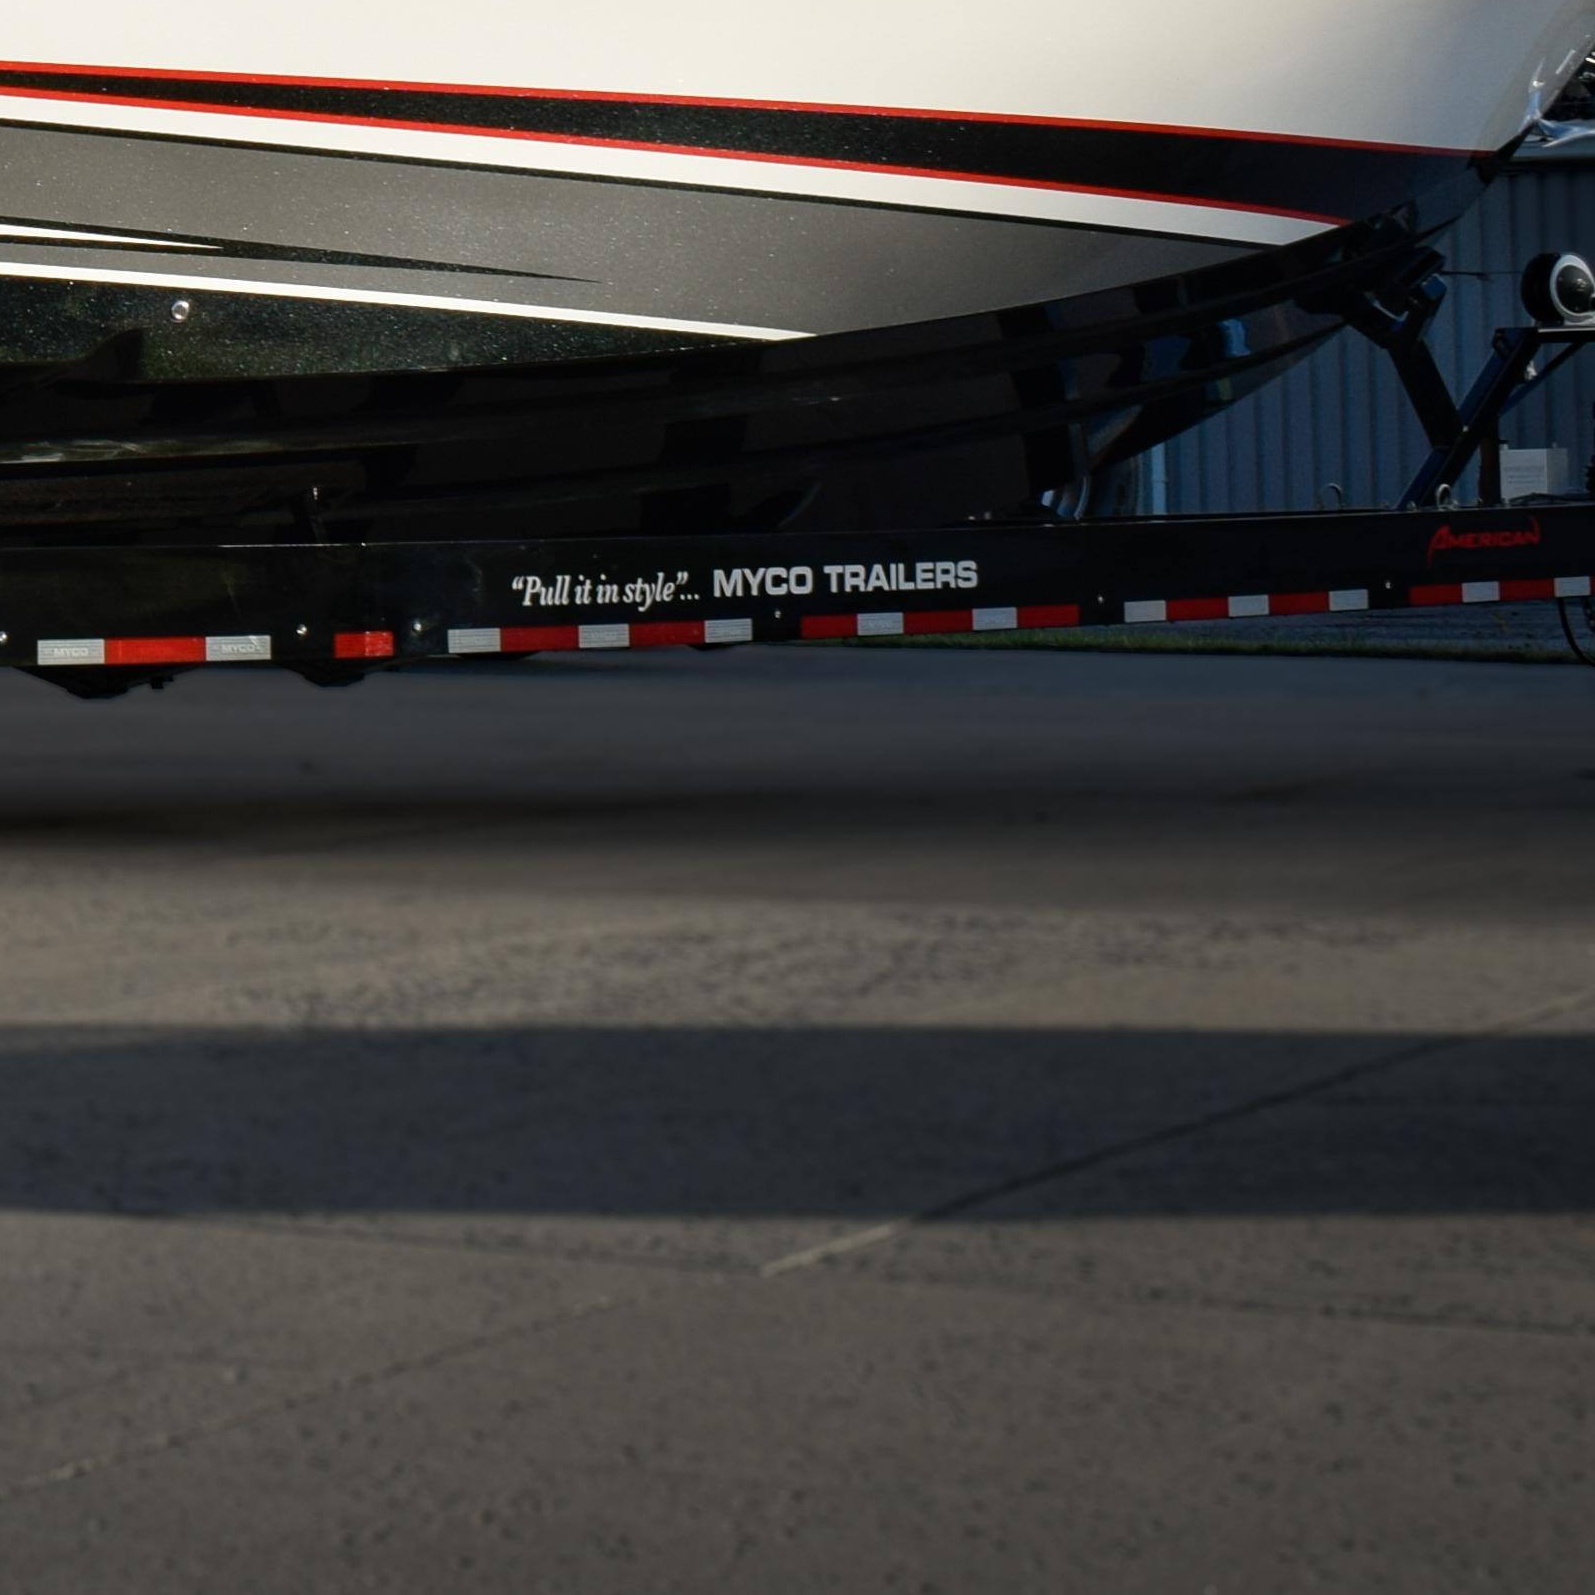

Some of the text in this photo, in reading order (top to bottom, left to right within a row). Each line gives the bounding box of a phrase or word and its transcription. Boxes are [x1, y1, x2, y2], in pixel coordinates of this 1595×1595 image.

[575, 574, 592, 604] it
[596, 573, 619, 604] in
[713, 560, 978, 597] MYCO TRAILERS
